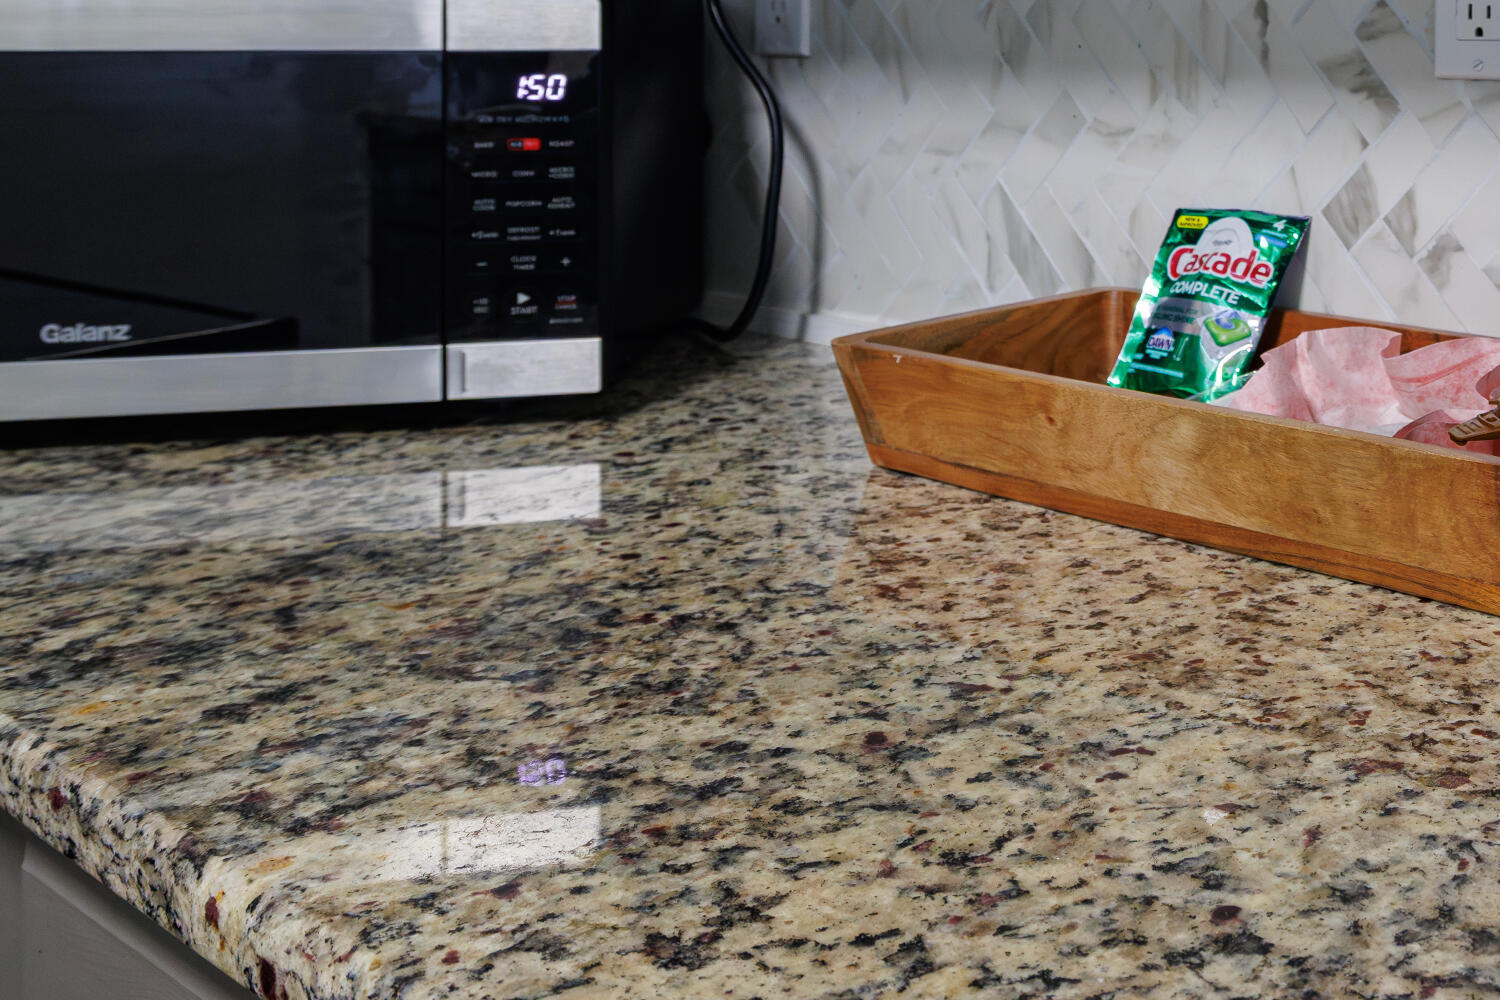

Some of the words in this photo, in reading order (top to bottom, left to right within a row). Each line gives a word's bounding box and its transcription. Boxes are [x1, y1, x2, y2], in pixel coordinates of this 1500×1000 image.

[1169, 247, 1273, 286] Cascade
[1169, 281, 1241, 305] COMPLETE
[39, 322, 133, 344] Galanz
